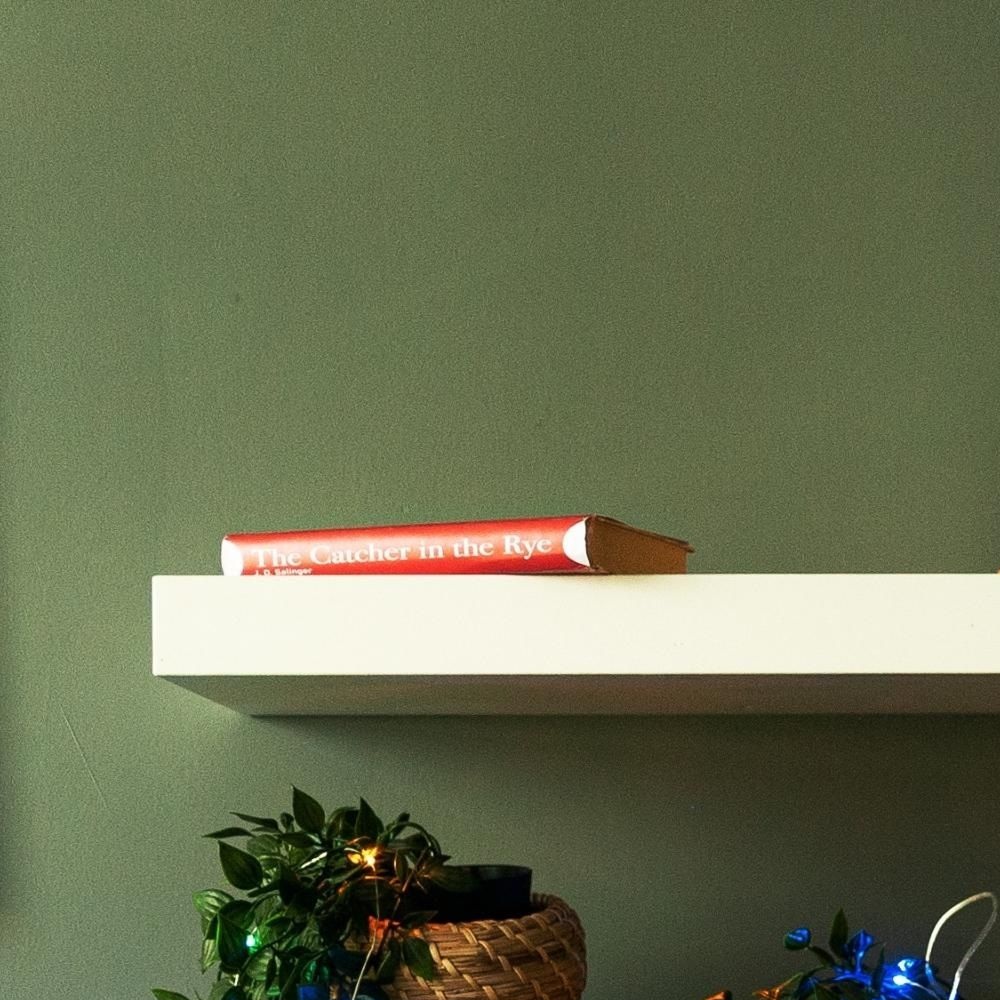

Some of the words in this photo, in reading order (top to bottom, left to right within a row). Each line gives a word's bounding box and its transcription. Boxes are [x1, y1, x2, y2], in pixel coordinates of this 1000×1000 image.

[252, 547, 301, 567] The
[310, 543, 411, 564] Catcher
[419, 540, 444, 559] in
[453, 538, 494, 557] the
[503, 534, 552, 559] Rye
